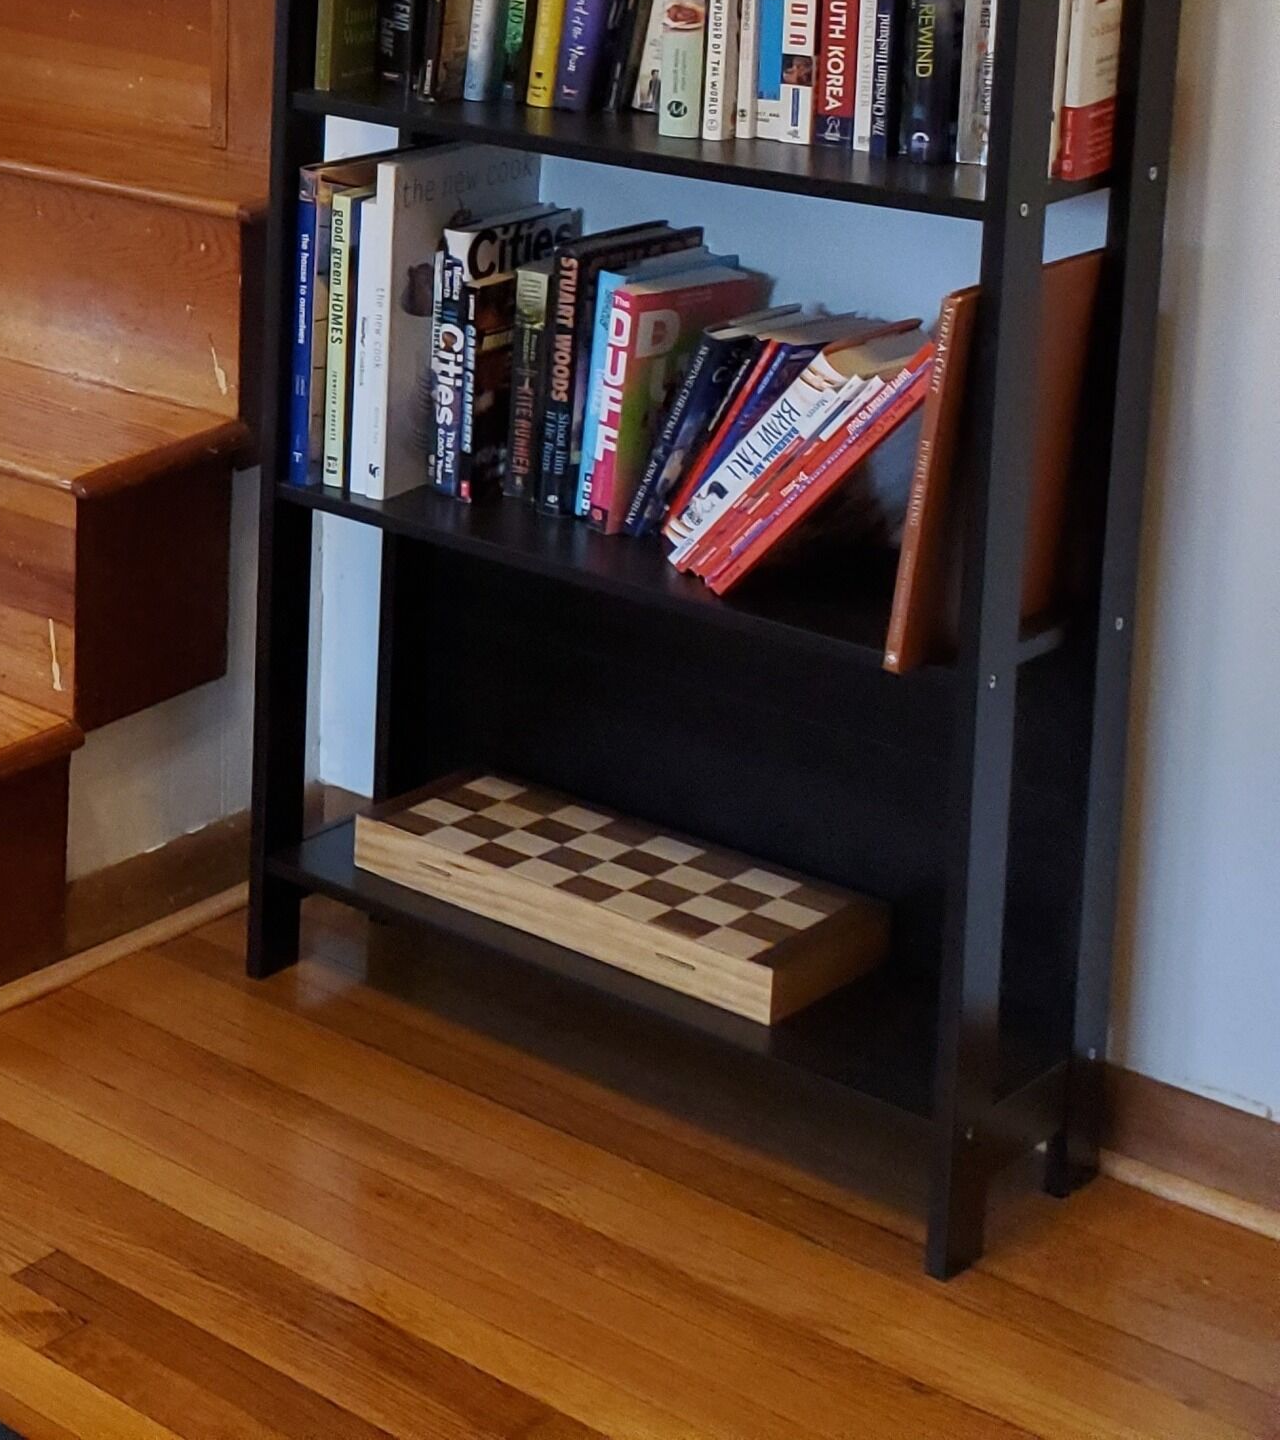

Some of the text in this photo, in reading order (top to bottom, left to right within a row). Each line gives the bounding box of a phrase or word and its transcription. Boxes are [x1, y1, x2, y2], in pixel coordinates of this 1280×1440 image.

[392, 0, 411, 32] END
[915, 2, 935, 78] REWIND
[567, 45, 586, 72] Moon
[825, 47, 845, 111] KOREA
[873, 13, 890, 136] The Christian Husband
[707, 78, 719, 115] WORLD
[403, 175, 435, 207] the
[488, 158, 533, 187] cook
[332, 210, 345, 243] good
[468, 222, 572, 280] Cities
[330, 292, 344, 345] HOMES
[614, 295, 630, 308] The
[464, 324, 476, 371] GAME
[551, 257, 579, 402] STUART WOODS
[373, 341, 383, 369] cook
[436, 323, 465, 426] Cities
[890, 368, 912, 391] HAPPY
[594, 308, 632, 461] DUFF
[663, 345, 709, 440] SKIPPING CHRISTMAS
[868, 384, 893, 412] BIRTHDAY
[461, 371, 474, 454] CHANGERS
[544, 424, 554, 439] He
[757, 398, 801, 450] BRAVE
[444, 431, 455, 473] The First
[511, 418, 532, 475] RUNNER
[542, 442, 552, 471] Runs
[554, 413, 570, 475] Shoot Him
[761, 425, 800, 468] BASEBALL
[627, 459, 658, 524] JOHN GRISHAM
[751, 461, 765, 479] ABC
